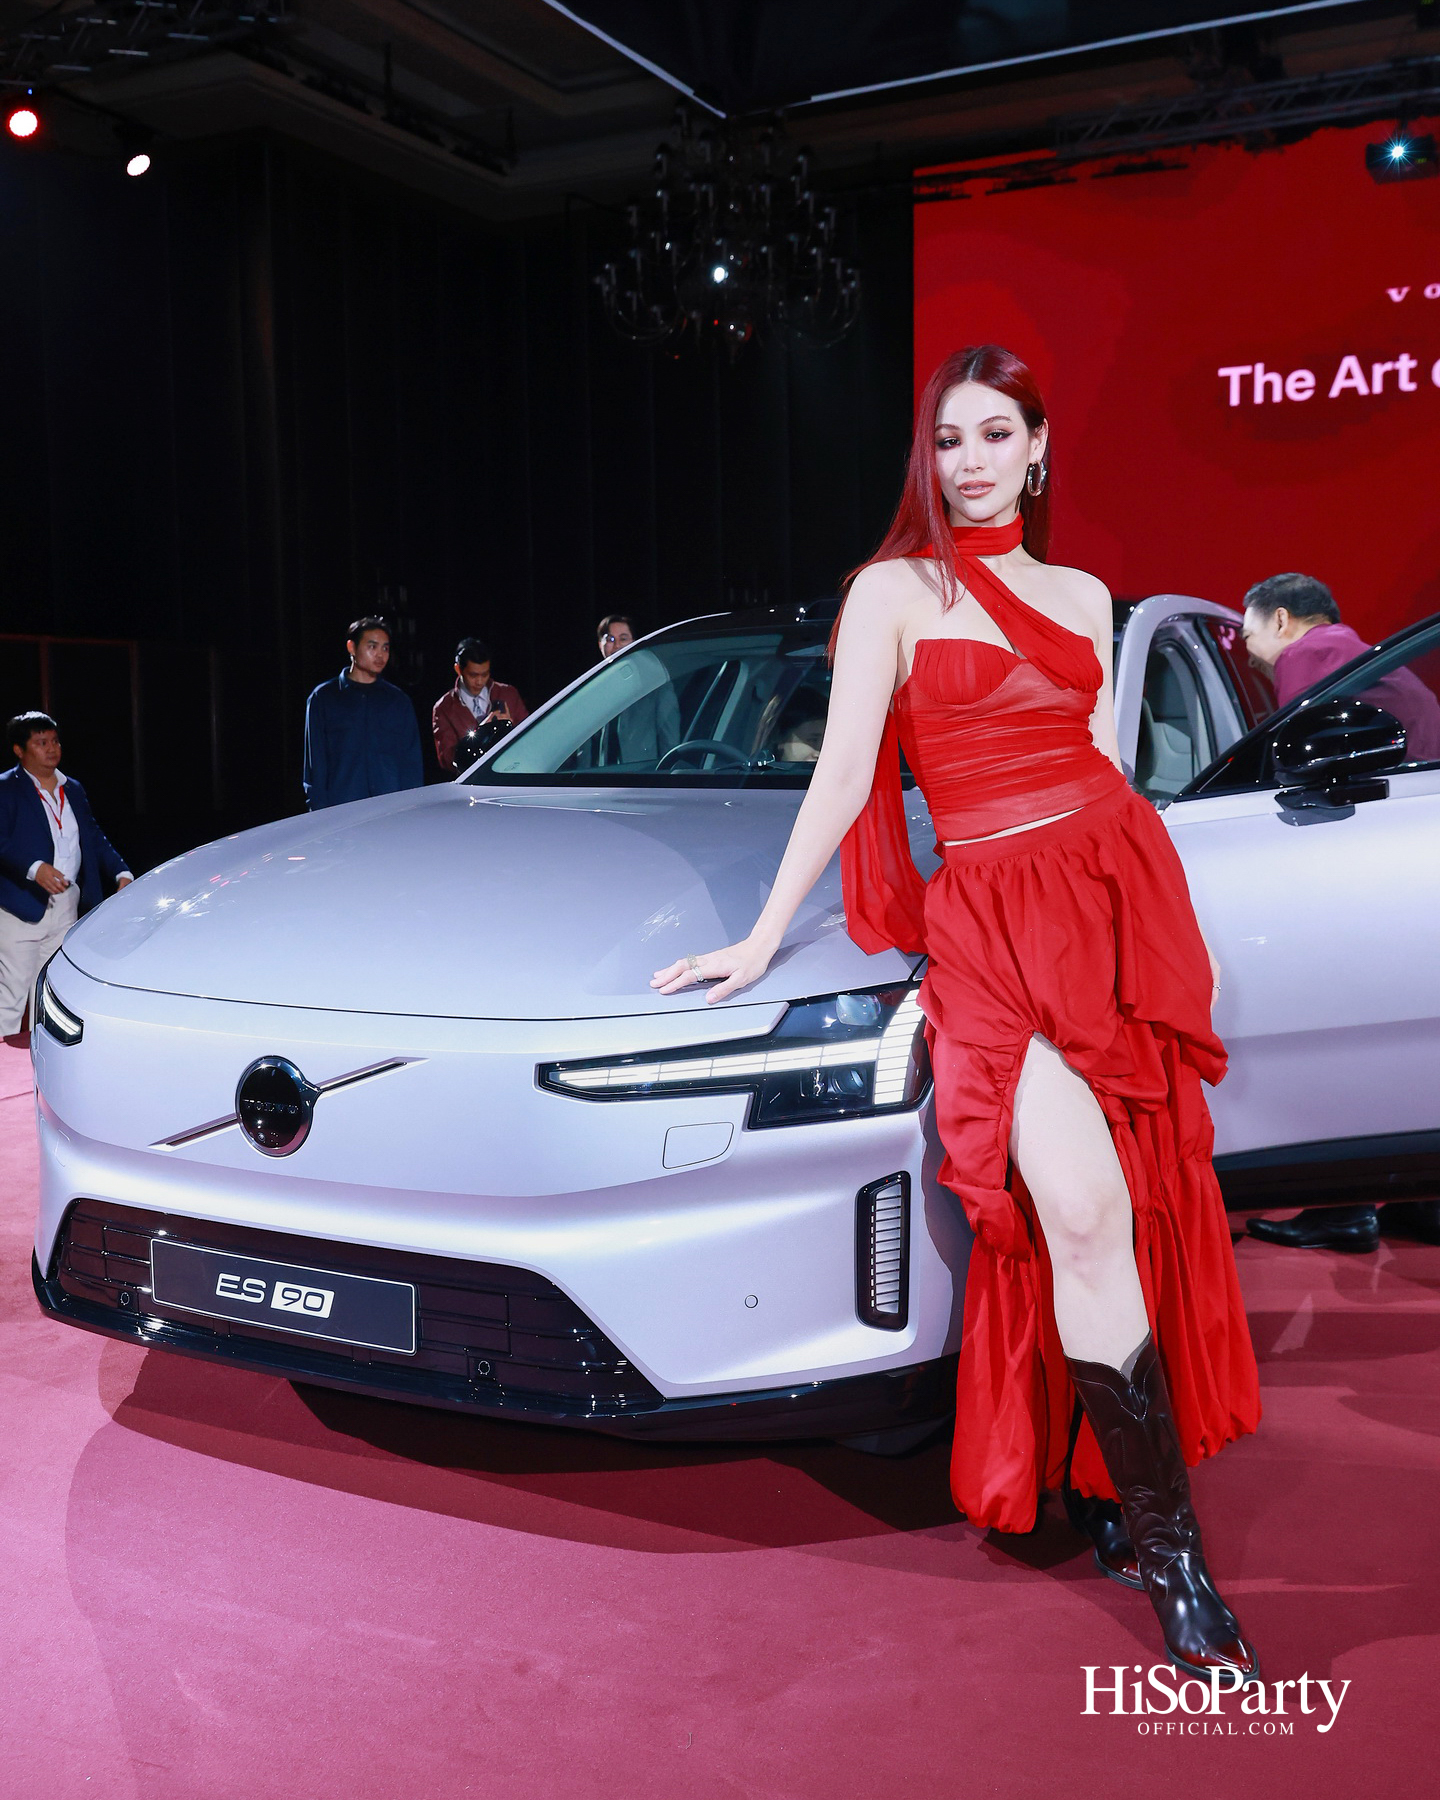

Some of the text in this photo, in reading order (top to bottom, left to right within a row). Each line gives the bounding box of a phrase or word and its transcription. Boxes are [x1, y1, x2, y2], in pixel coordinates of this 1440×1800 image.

[1217, 362, 1316, 407] The
[1328, 353, 1418, 398] Art
[215, 1273, 327, 1314] ES 90
